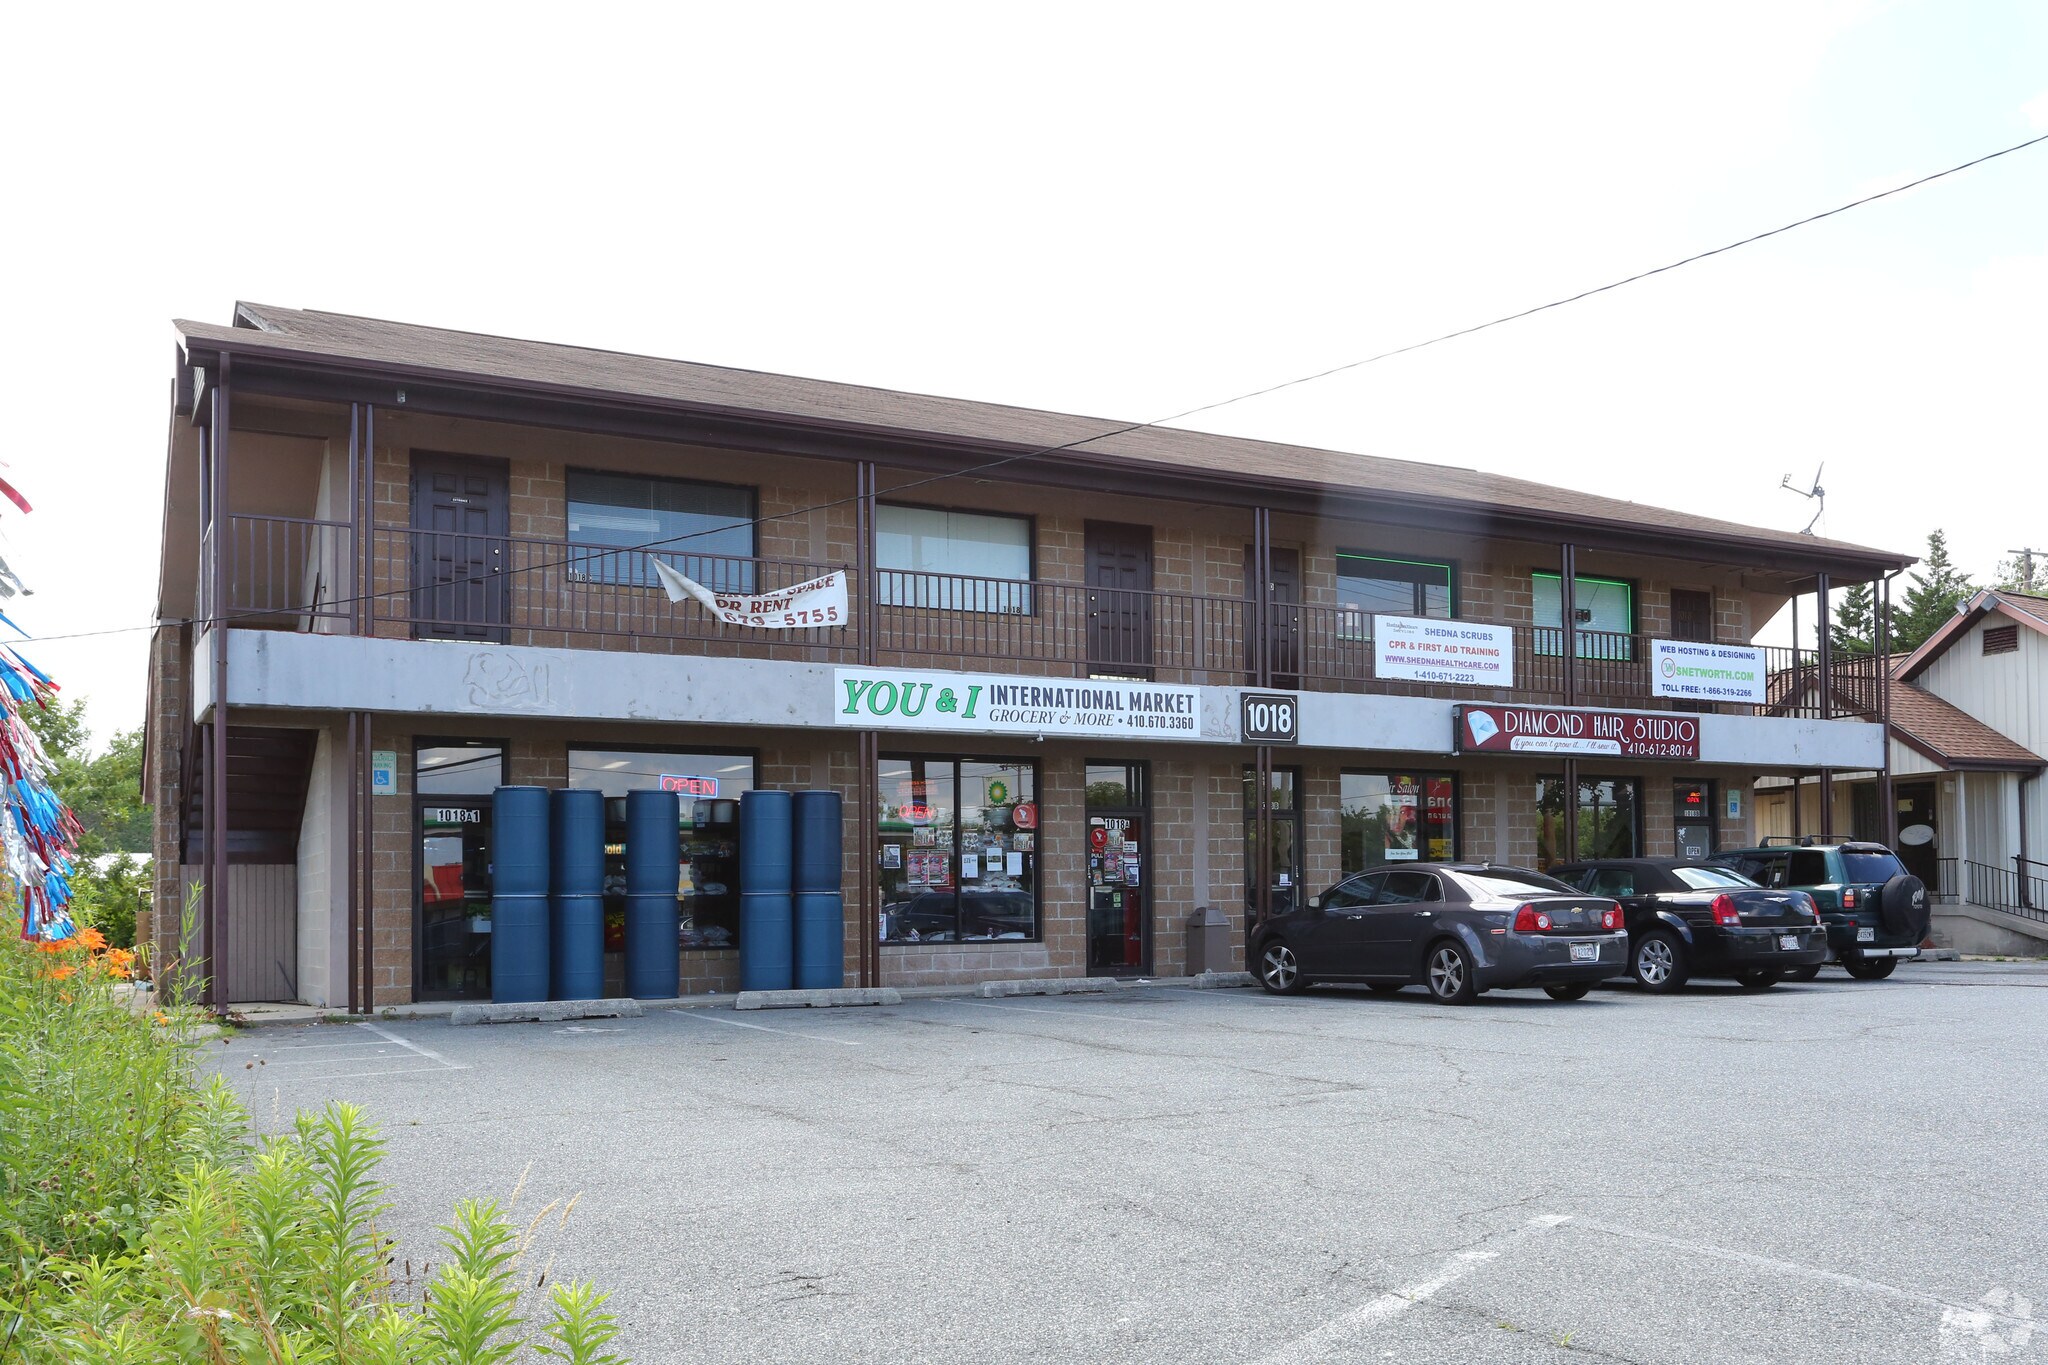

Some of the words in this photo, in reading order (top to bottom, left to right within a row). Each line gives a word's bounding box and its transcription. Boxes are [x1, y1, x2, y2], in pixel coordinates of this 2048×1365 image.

[749, 597, 793, 614] RENT
[1425, 627, 1458, 639] SHEDNA
[1460, 631, 1494, 642] SCRUBS
[1389, 640, 1407, 650] CPR
[1409, 642, 1416, 650] &
[1418, 642, 1442, 653] FIRST
[1444, 644, 1458, 654] AID
[1460, 646, 1500, 657] TRAINING
[1660, 645, 1676, 654] WEB
[1678, 647, 1710, 657] HOSTING
[1718, 650, 1756, 660] DESIGNING
[1385, 654, 1500, 671] WWW.SHEDNAHEALTHCARE.COM
[1414, 670, 1475, 682] 1-410-671-2223
[1676, 665, 1755, 681] SNETWORTH.COM
[1661, 683, 1680, 692] TOLL
[1681, 685, 1701, 694] FREE:
[1702, 687, 1752, 697] 1-866-319-2266
[842, 679, 933, 717] YOU
[935, 687, 959, 713] &
[961, 685, 983, 719] I
[990, 684, 1125, 711] INTERNATIONAL
[1129, 691, 1194, 714] MARKET
[989, 708, 1057, 724] GROCERY
[1059, 712, 1071, 725] &
[1073, 712, 1115, 727] MORE
[1127, 714, 1194, 730] 410.670.3360
[1247, 703, 1292, 733] 1018
[1504, 711, 1584, 737] DIAMOND
[1593, 715, 1630, 743] HAIR
[1633, 717, 1695, 742] STUDIO
[1520, 741, 1534, 750] you
[1535, 740, 1554, 748] can't
[1554, 742, 1571, 751] grow
[1628, 742, 1693, 757] 410-612-8014
[662, 776, 716, 795] OPEN
[1397, 781, 1420, 795] Salon
[438, 810, 480, 822] 1018A1
[899, 804, 935, 819] OPEN
[605, 844, 622, 855] old
